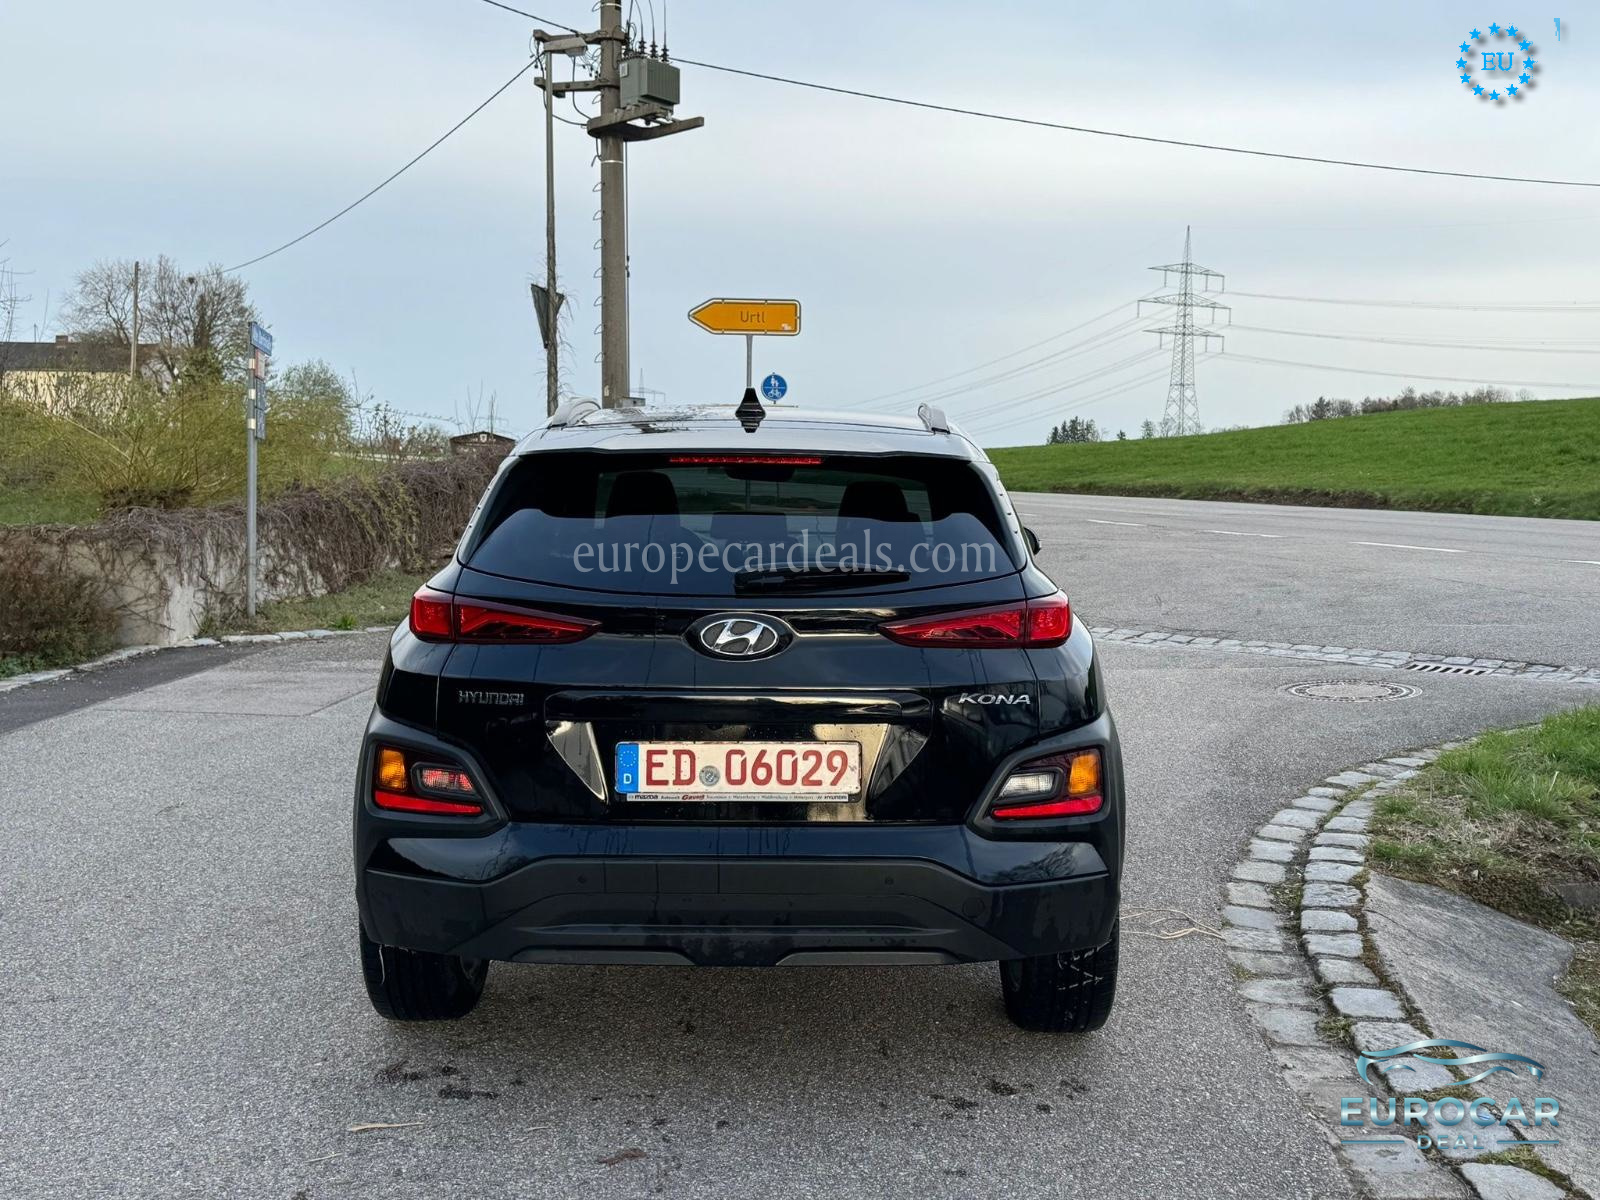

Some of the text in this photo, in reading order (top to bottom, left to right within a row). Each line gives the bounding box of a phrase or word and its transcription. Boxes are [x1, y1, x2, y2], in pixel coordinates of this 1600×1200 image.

[740, 311, 766, 323] Urtl
[458, 690, 524, 705] HYUNDAI
[958, 692, 1031, 704] KONA
[646, 749, 849, 786] ED 06029
[623, 773, 632, 784] D
